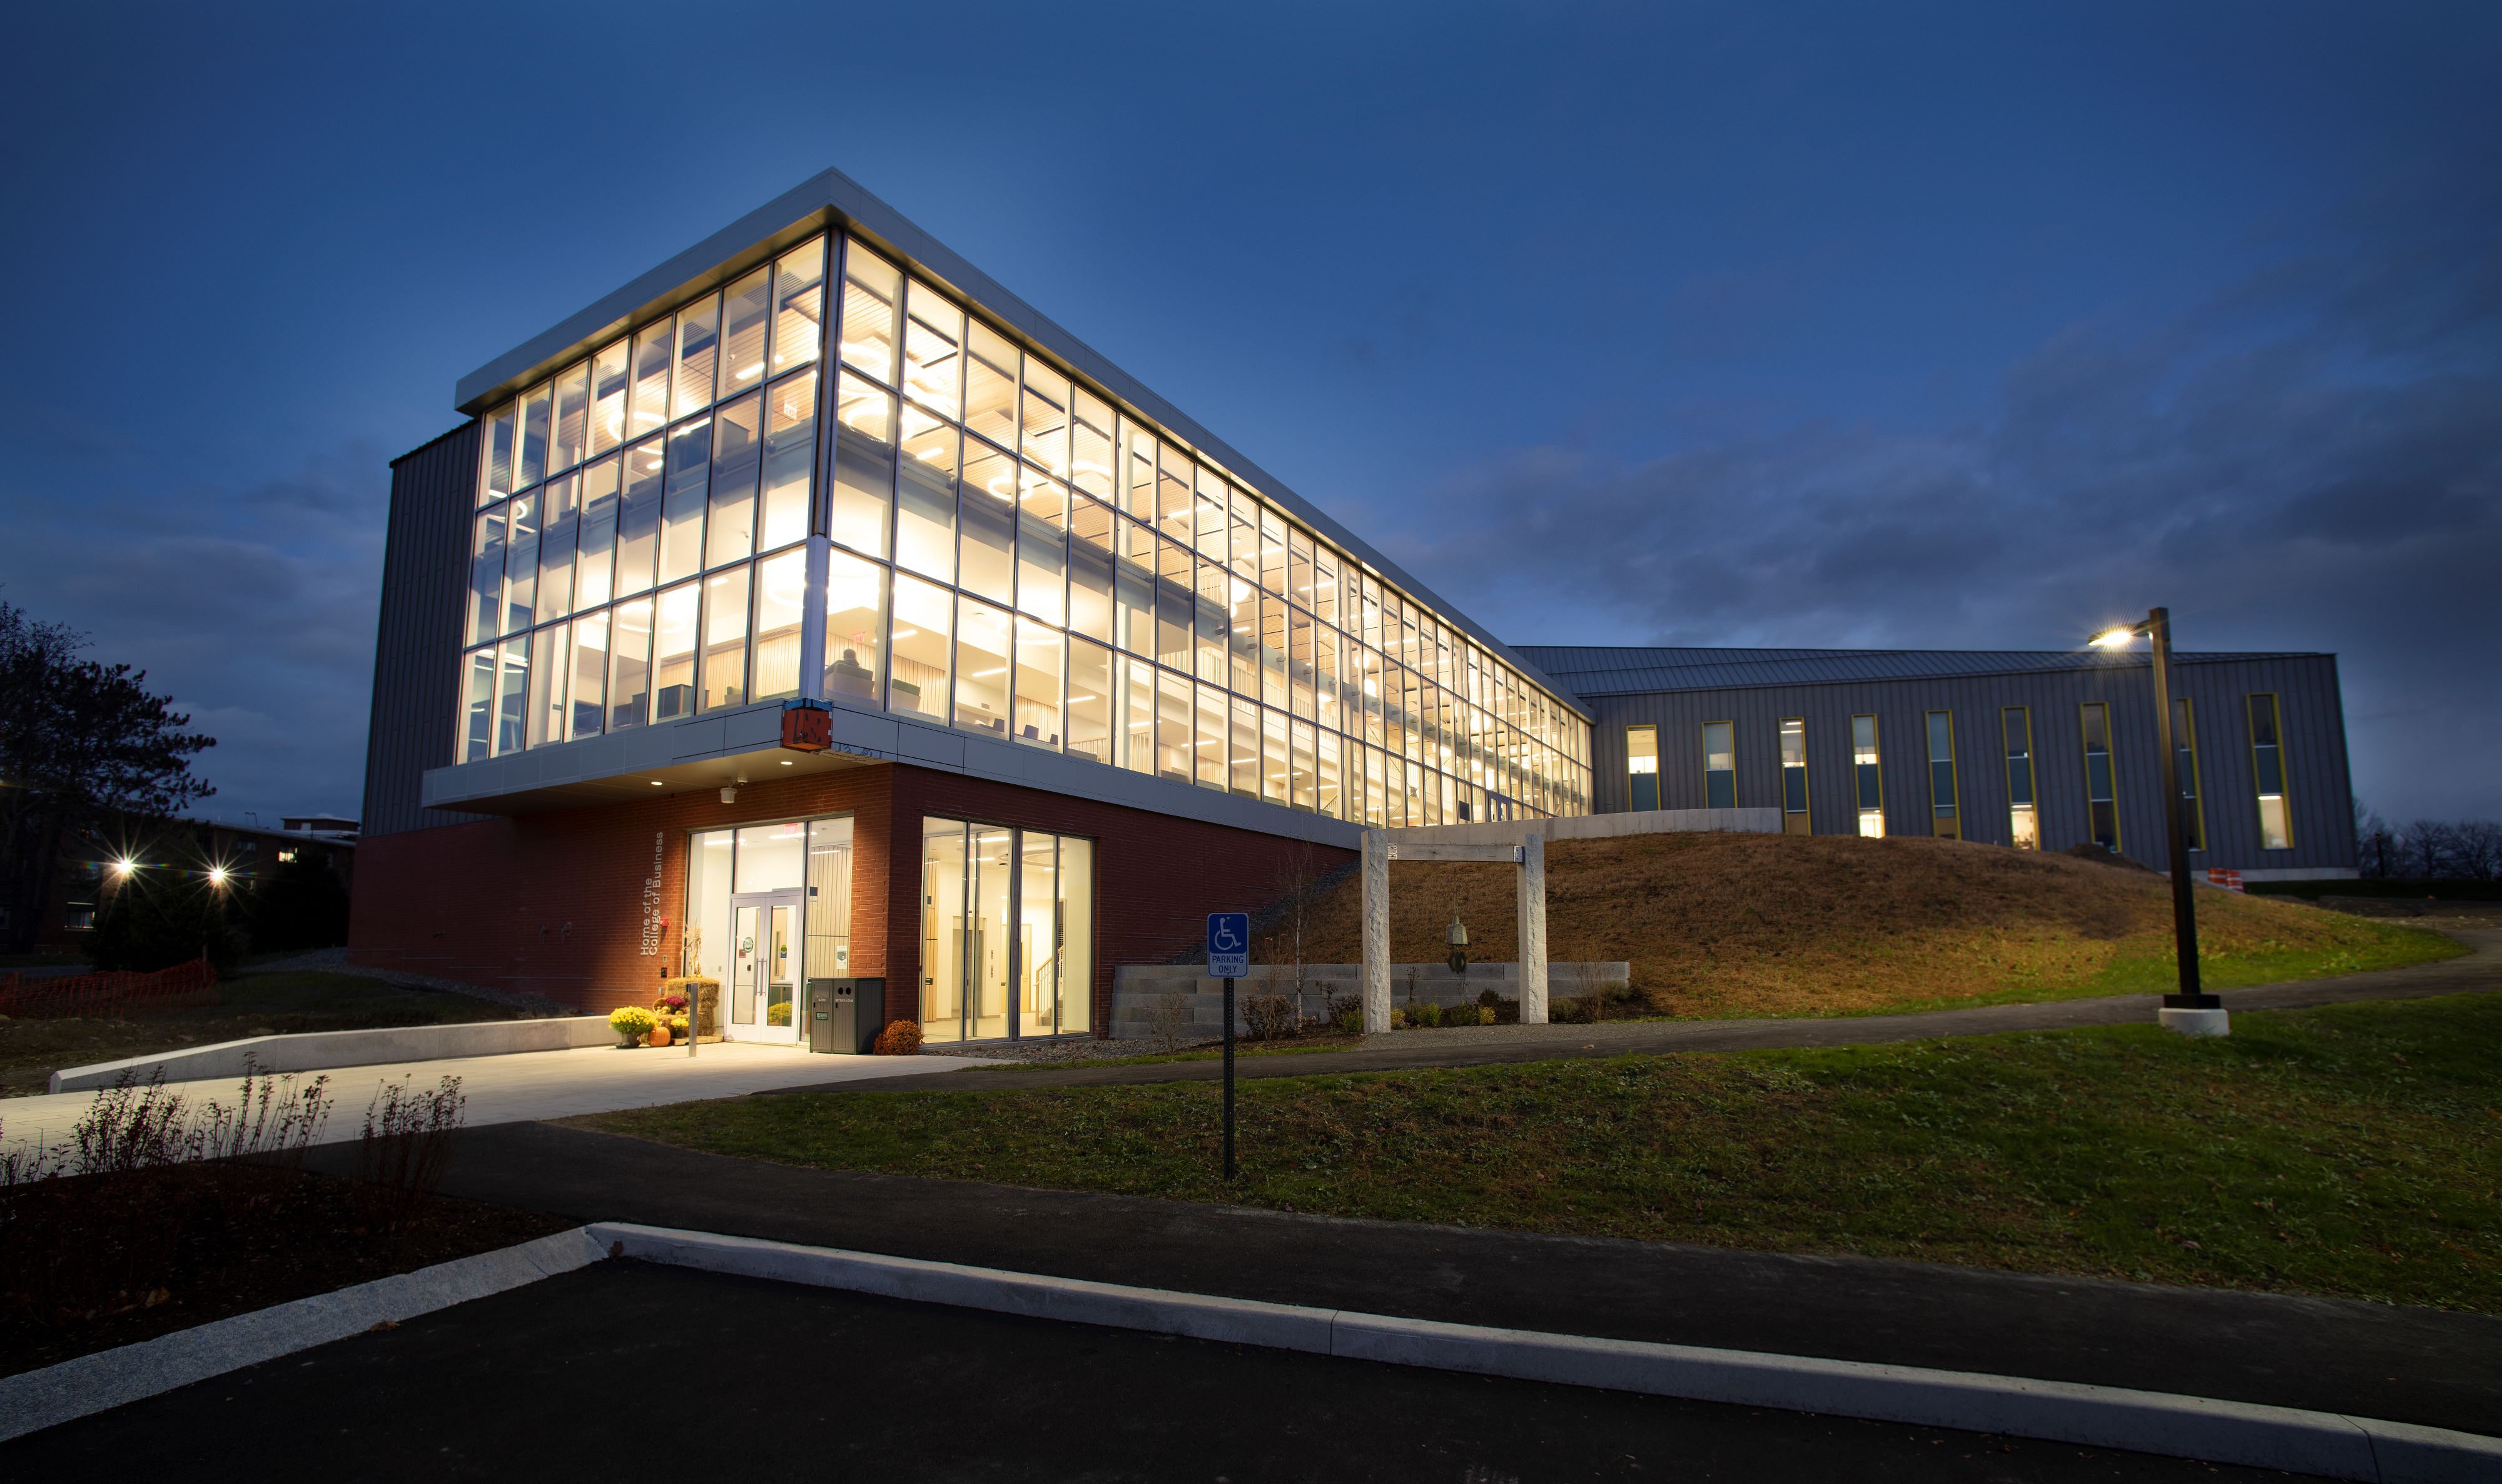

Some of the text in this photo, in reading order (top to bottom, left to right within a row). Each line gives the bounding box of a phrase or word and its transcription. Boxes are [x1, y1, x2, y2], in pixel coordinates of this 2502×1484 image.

[649, 831, 663, 956] College of Business
[641, 877, 652, 956] Home of the
[1212, 955, 1243, 964] PARKING
[1218, 965, 1237, 973] ONLY
